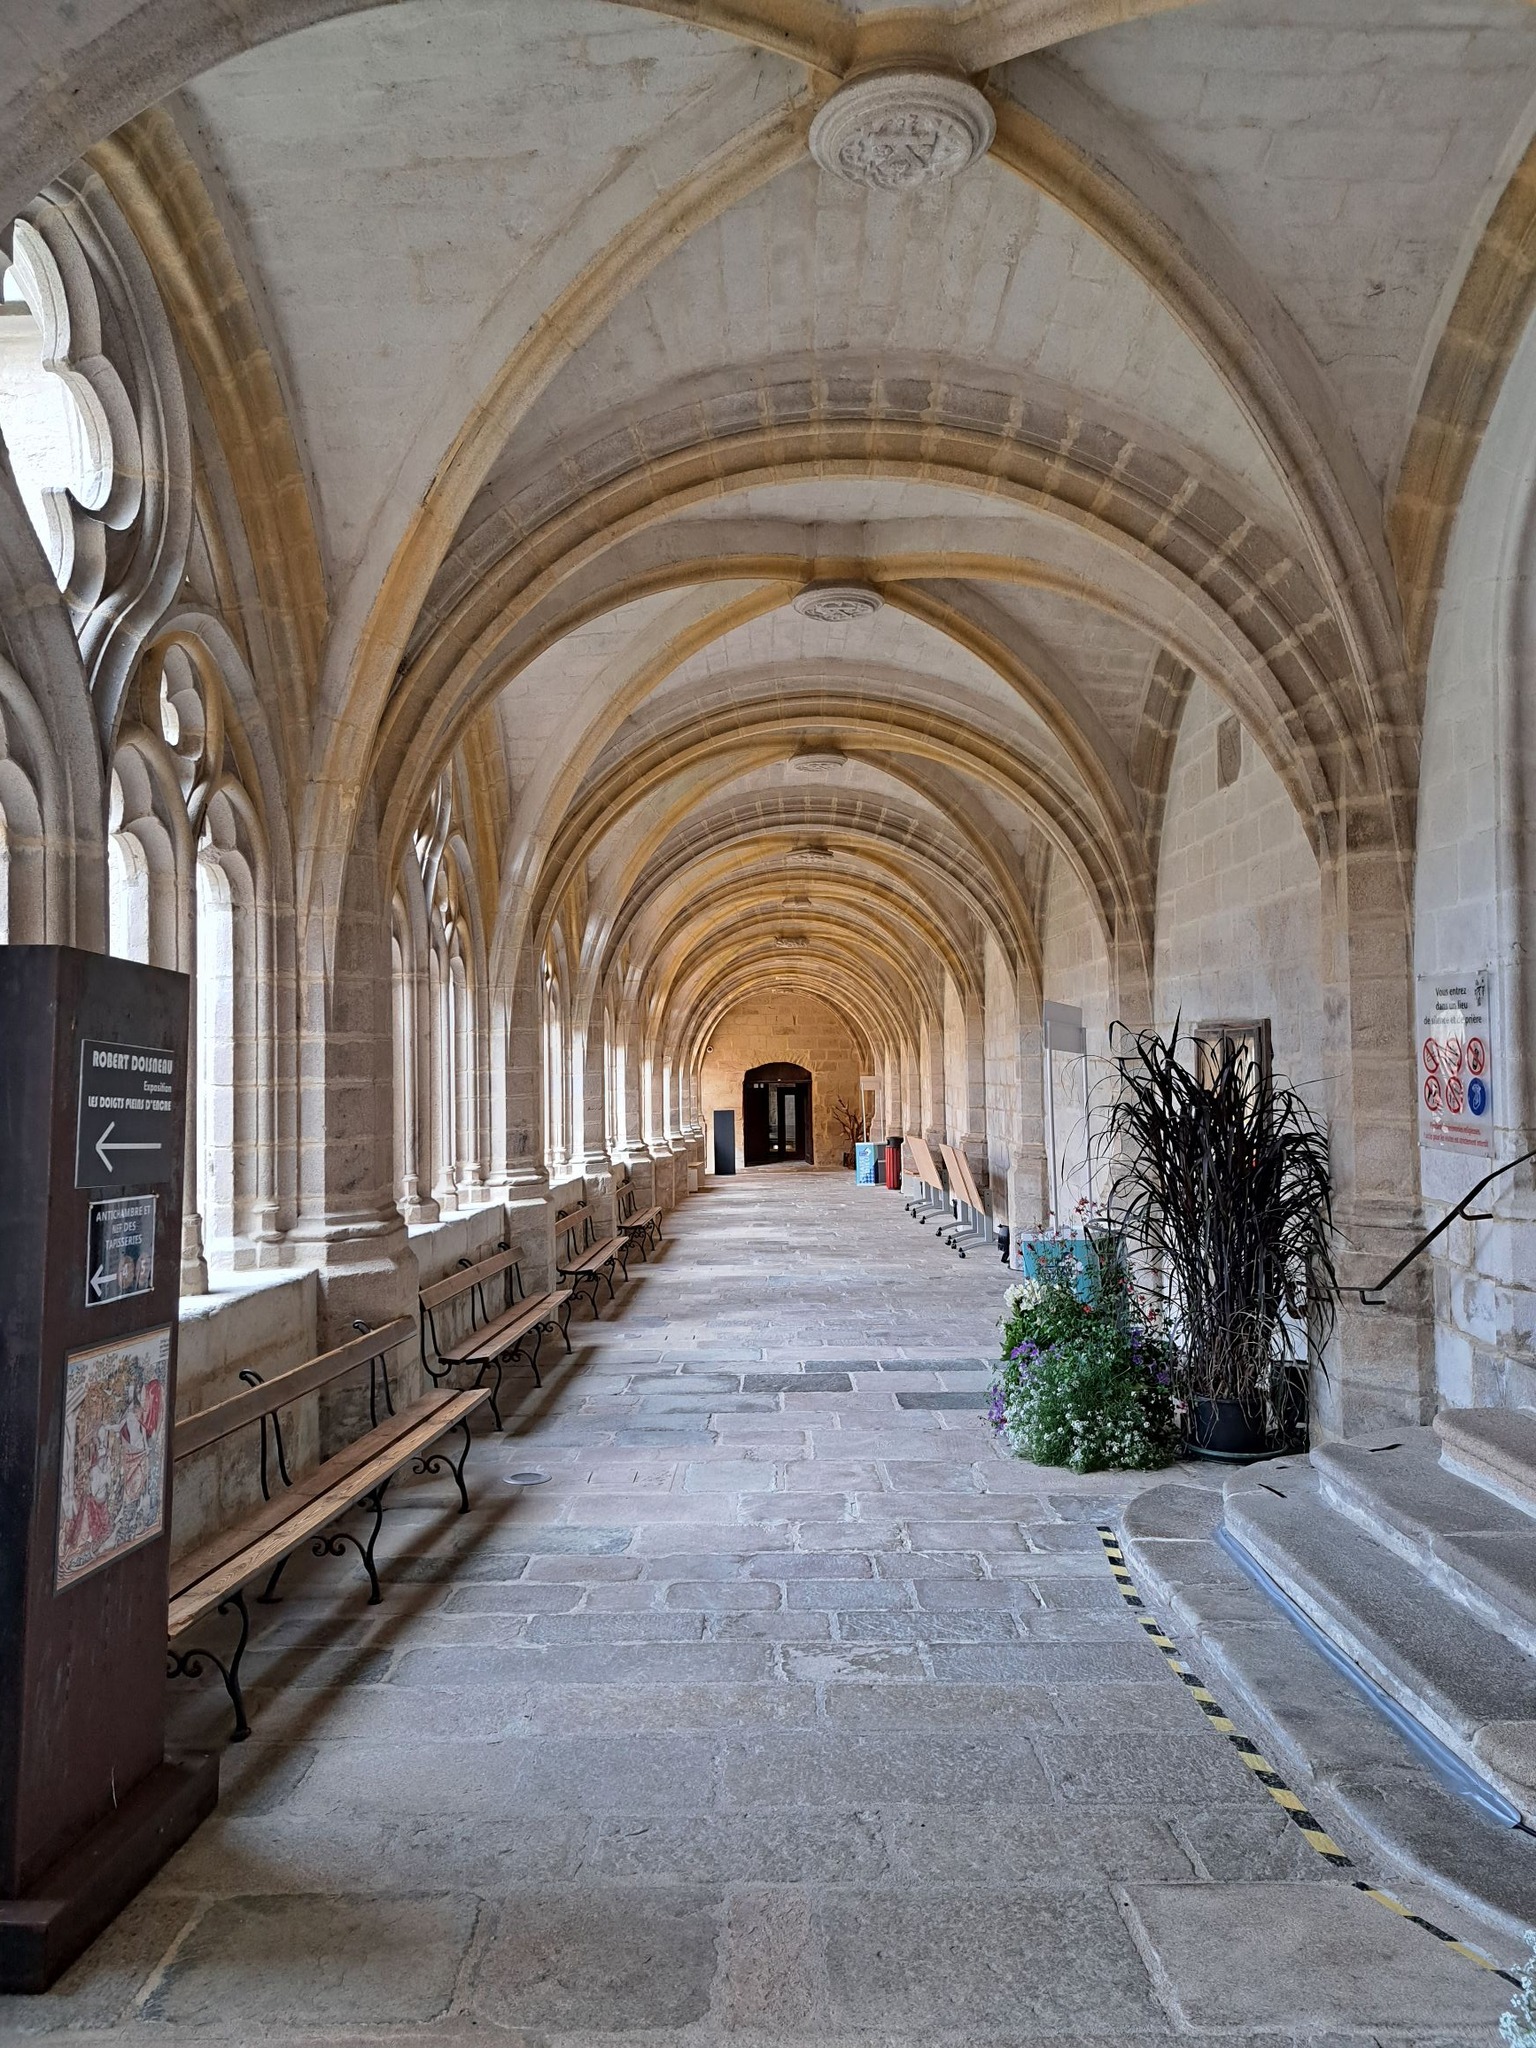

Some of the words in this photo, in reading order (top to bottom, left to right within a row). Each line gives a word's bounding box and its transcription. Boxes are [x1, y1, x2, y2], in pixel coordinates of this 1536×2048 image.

[1435, 986, 1448, 996] Vous
[1449, 986, 1467, 996] entrez
[1435, 1000, 1448, 1010] dans
[1448, 1002, 1457, 1010] un
[1457, 1000, 1468, 1009] lieu
[1423, 1015, 1431, 1025] de
[1465, 1013, 1482, 1027] prière
[92, 1050, 130, 1070] ROBERT
[131, 1055, 173, 1075] DOISNEAU
[143, 1080, 172, 1094] Exposition
[88, 1095, 99, 1108] LES
[99, 1096, 125, 1109] DOIGTS
[125, 1098, 144, 1110] PLEINS
[145, 1099, 172, 1111] D'ENCRE
[96, 1206, 143, 1222] ANTICHAMBRE
[143, 1205, 151, 1215] ET
[112, 1223, 123, 1234] NEF
[123, 1221, 137, 1232] DES
[105, 1234, 143, 1250] TAPISSERIES
[122, 1263, 128, 1278] 4
[140, 1259, 146, 1275] 5
